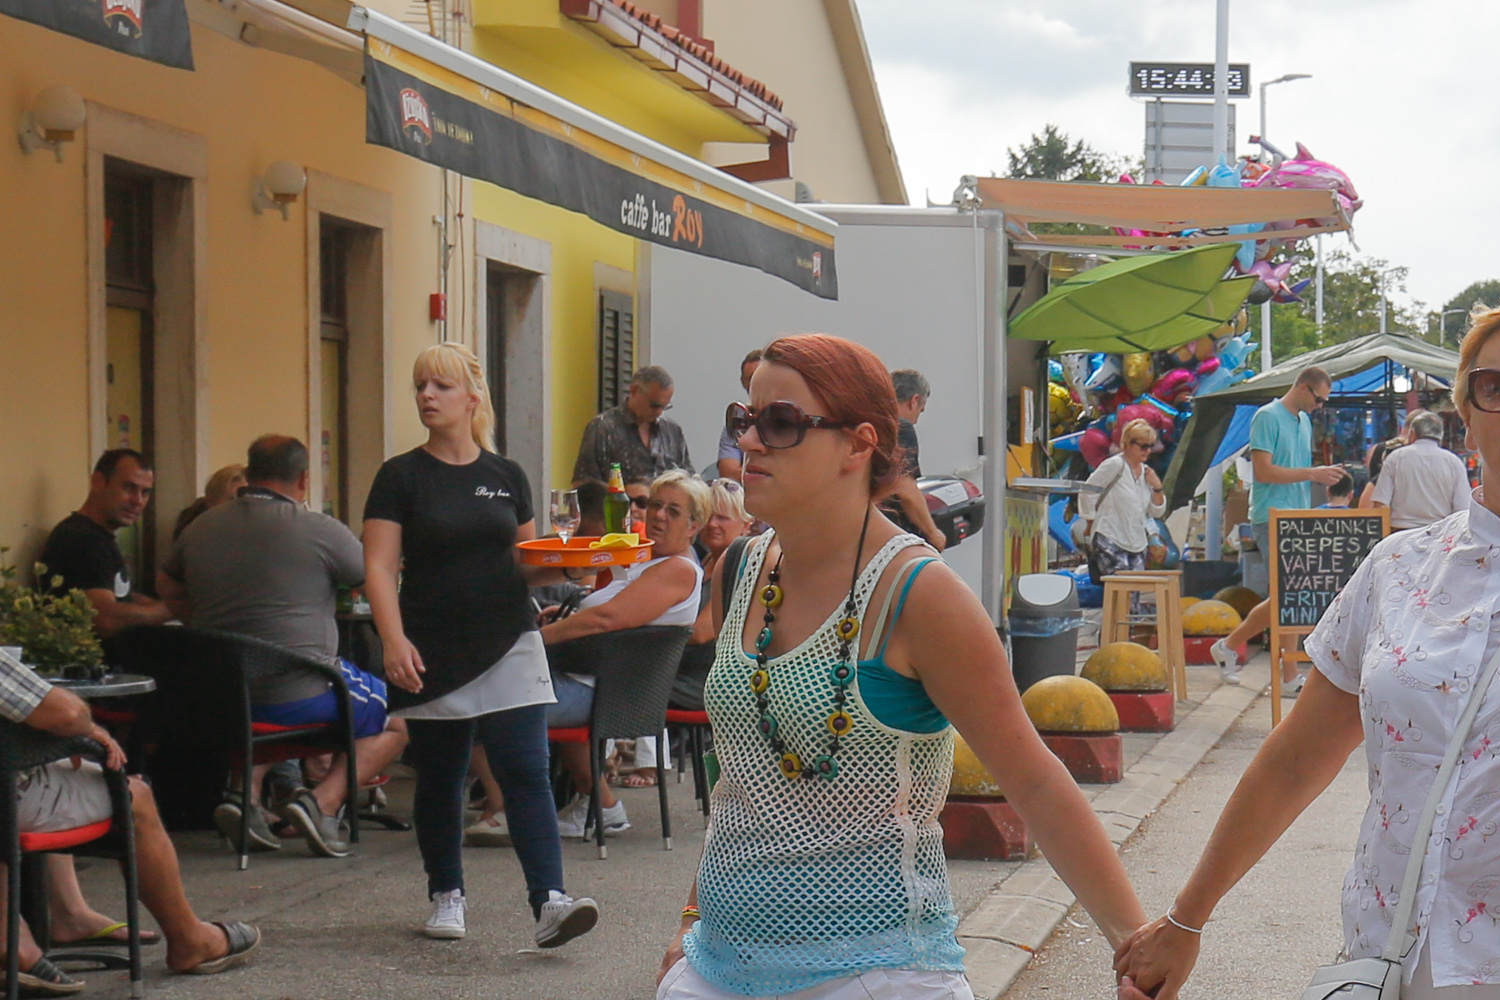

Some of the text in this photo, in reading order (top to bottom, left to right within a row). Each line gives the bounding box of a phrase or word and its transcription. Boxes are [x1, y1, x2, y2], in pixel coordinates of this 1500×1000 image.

[1136, 69, 1242, 89] 15:44:3
[620, 193, 649, 230] caffe
[651, 199, 671, 237] bar
[1279, 518, 1380, 535] PALAČINKE
[1279, 537, 1361, 553] CREPES
[1281, 554, 1345, 574] VAFLE
[1284, 575, 1351, 591] WAFFL
[1284, 590, 1335, 607] FRIT
[1280, 607, 1318, 623] MINI
